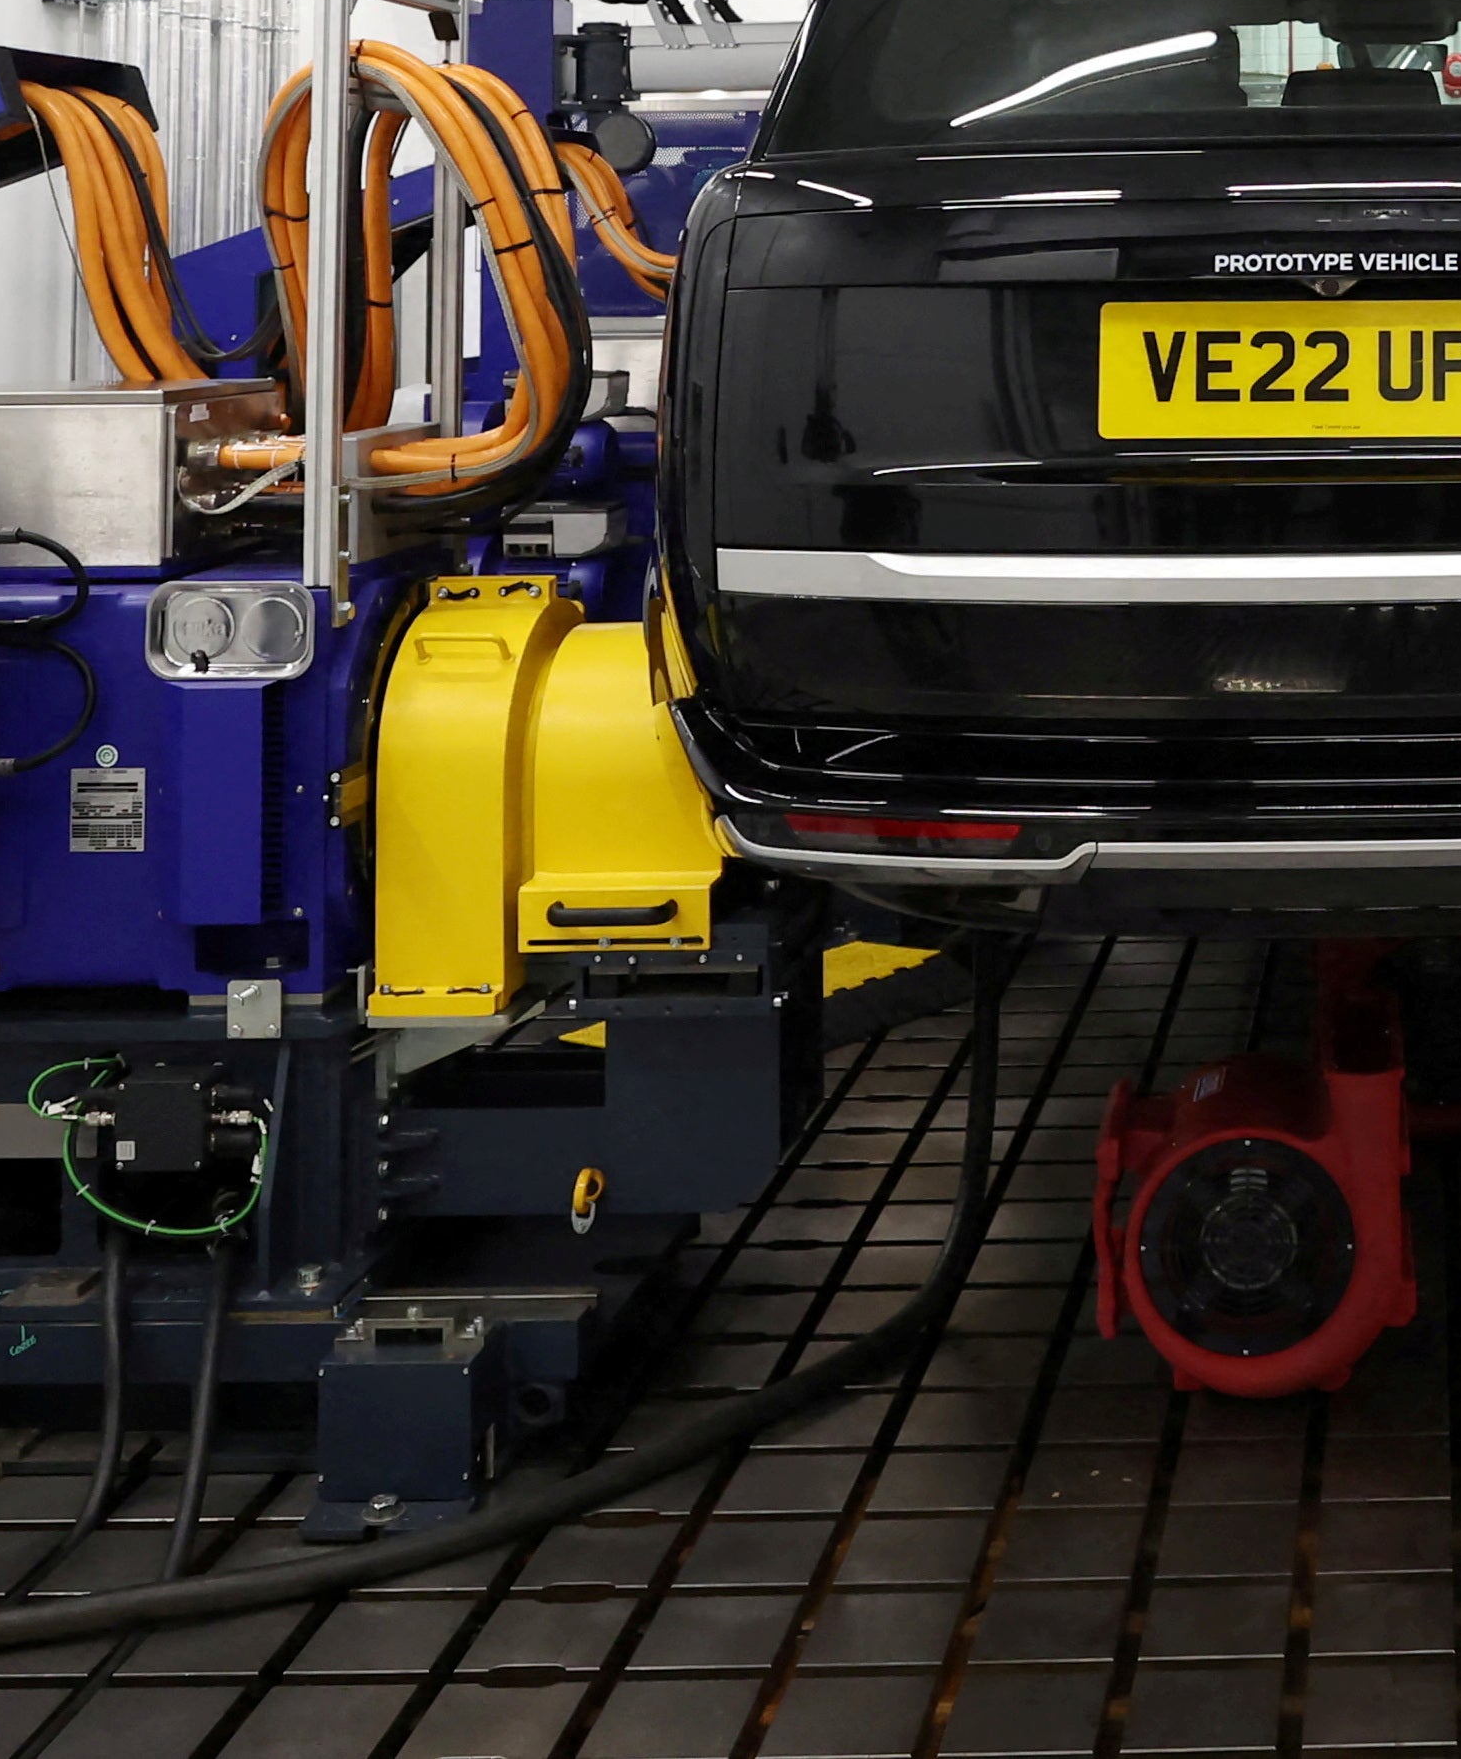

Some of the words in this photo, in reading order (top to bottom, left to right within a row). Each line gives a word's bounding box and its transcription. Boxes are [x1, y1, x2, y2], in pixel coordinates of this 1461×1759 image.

[1214, 252, 1354, 271] PROTOTYPE
[1358, 252, 1459, 271] VEHICLE
[1142, 329, 1350, 403] VE22
